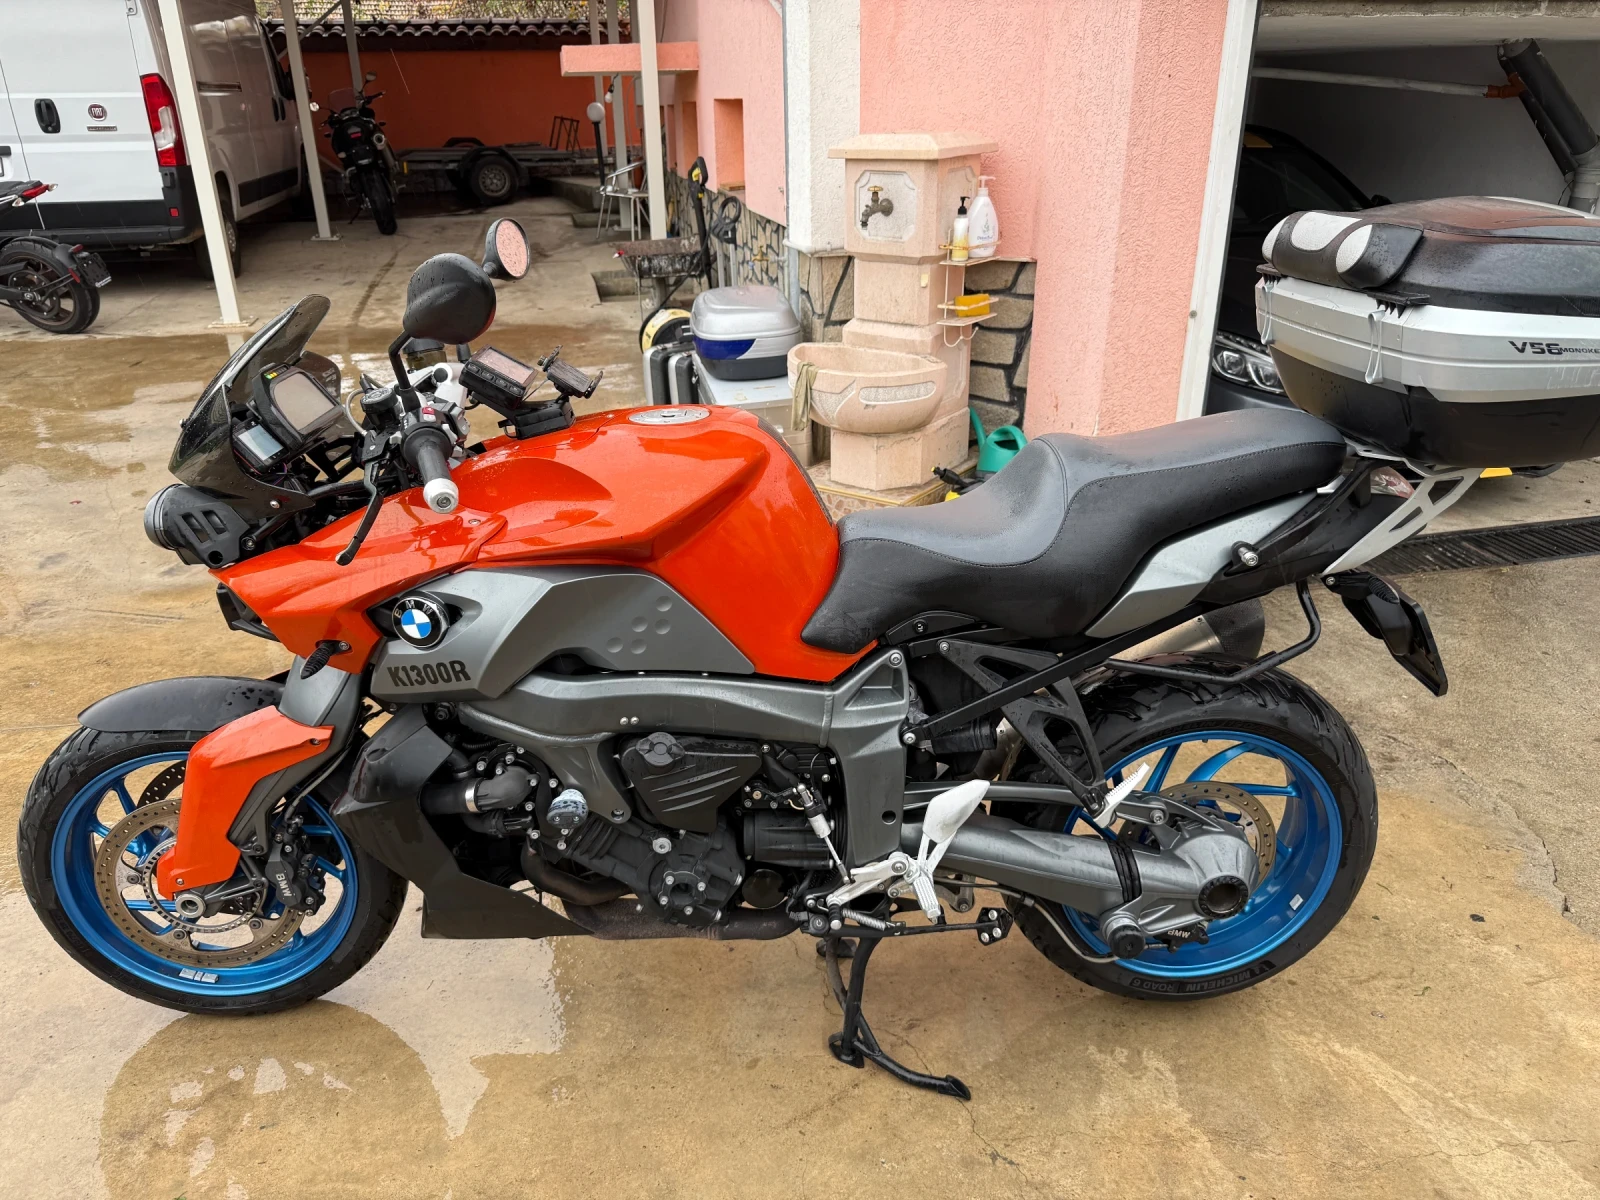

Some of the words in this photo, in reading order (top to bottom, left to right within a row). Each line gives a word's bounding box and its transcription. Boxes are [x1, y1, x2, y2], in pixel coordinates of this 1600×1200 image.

[91, 107, 103, 117] FIAT
[1508, 340, 1563, 356] V56
[394, 600, 434, 619] BMW
[387, 660, 471, 687] K1300R
[276, 873, 292, 897] BMW
[1131, 978, 1141, 986] 6
[1143, 980, 1174, 992] ROAD
[1186, 971, 1251, 992] MICHELIN
